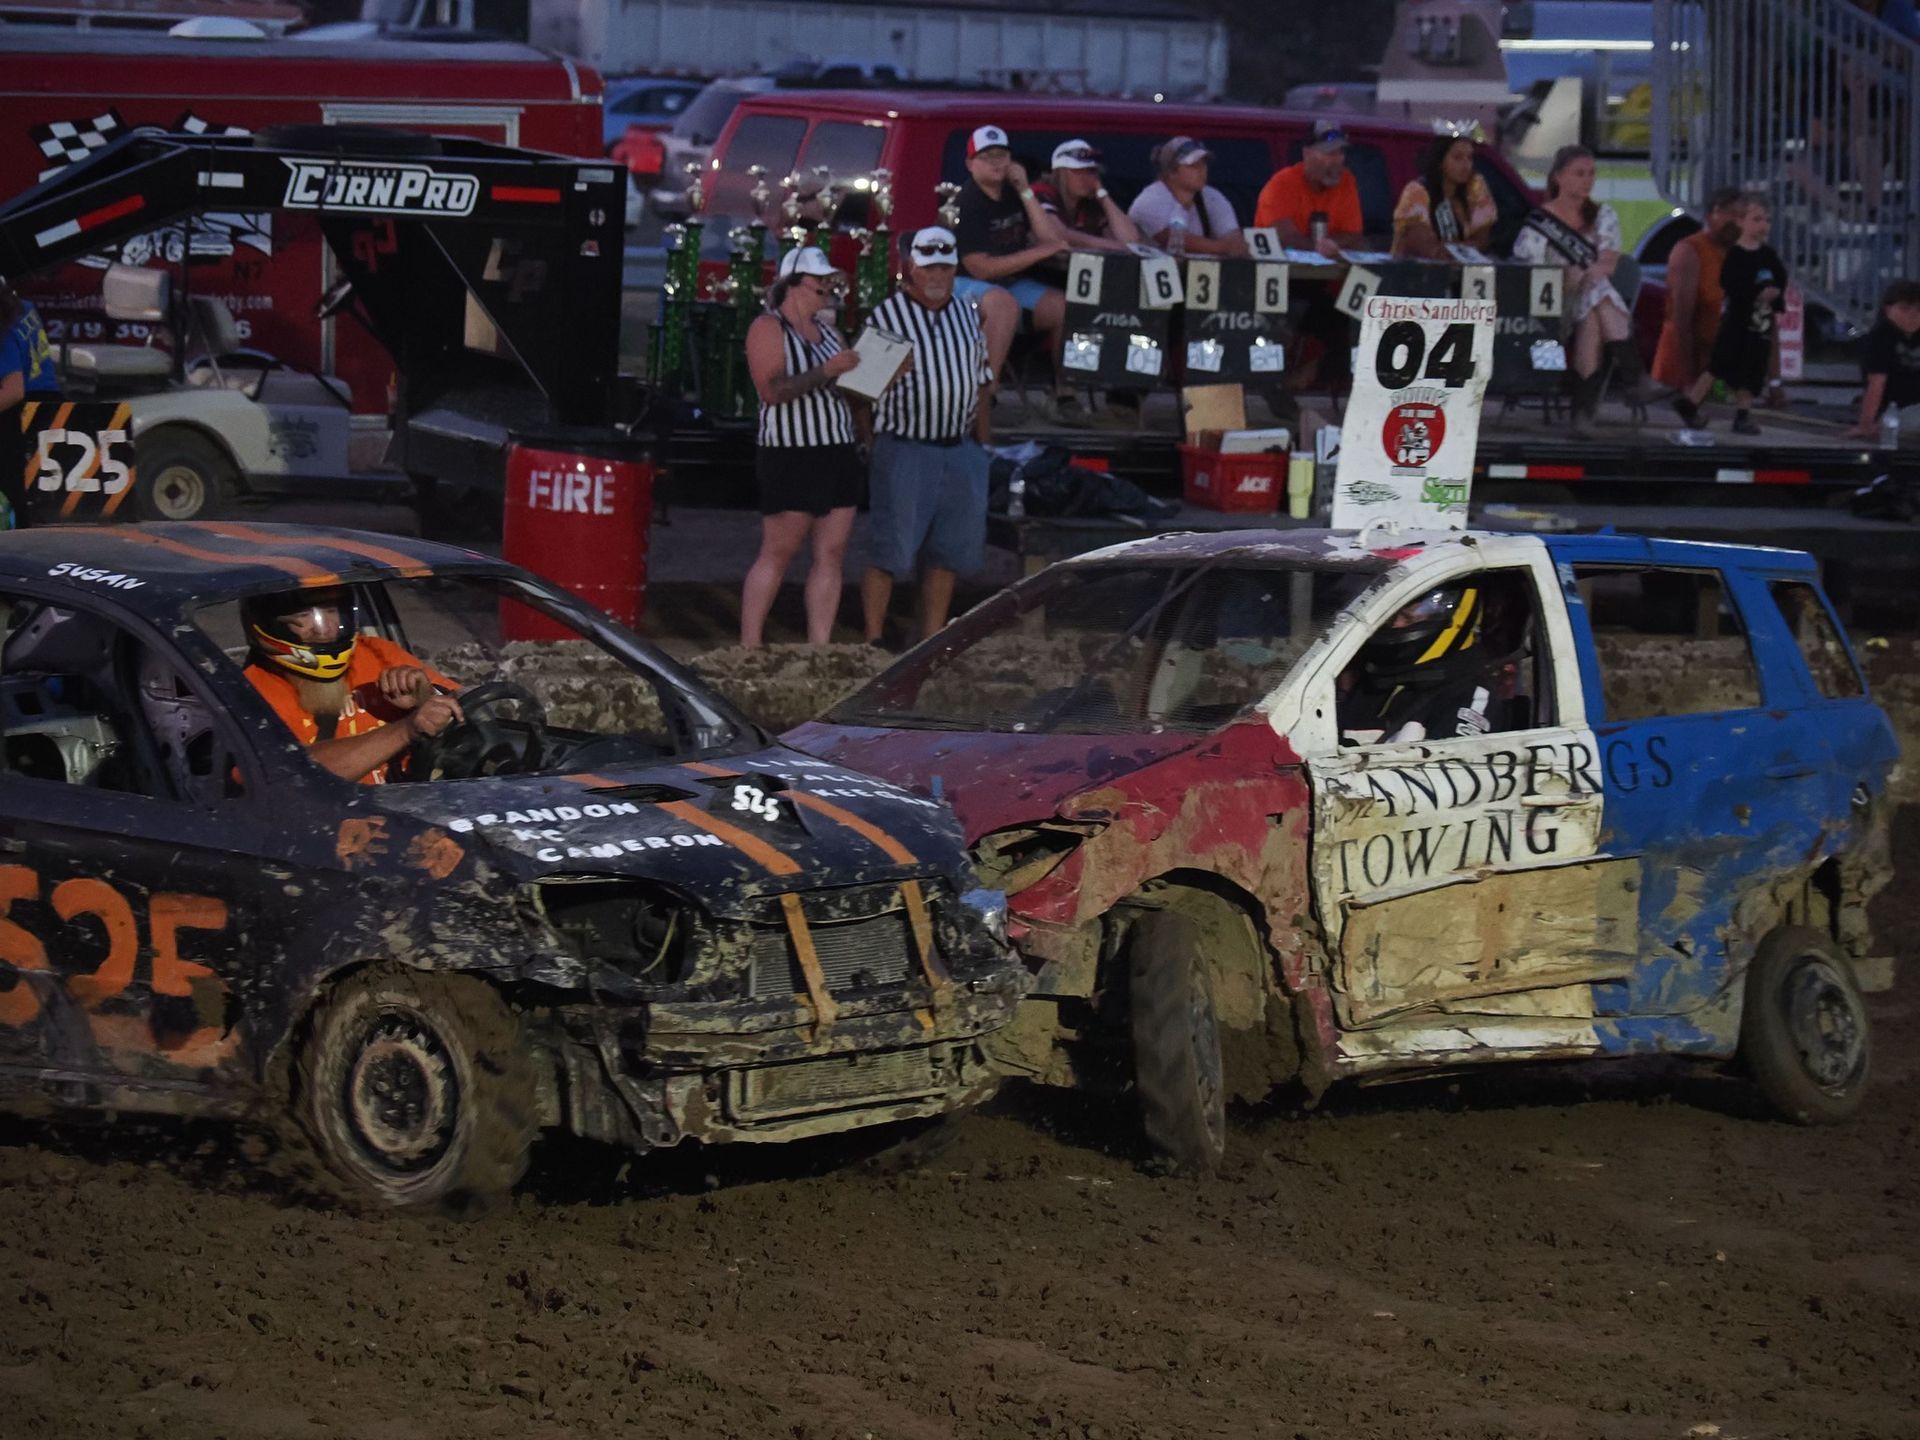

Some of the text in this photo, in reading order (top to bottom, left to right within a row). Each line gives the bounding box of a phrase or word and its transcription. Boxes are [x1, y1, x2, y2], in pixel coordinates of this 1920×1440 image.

[1254, 233, 1271, 254] 9
[1078, 268, 1093, 297] 6
[1156, 271, 1172, 298] 6
[1196, 274, 1210, 303] 3
[1265, 278, 1279, 305] 6
[1348, 283, 1367, 310] 6
[1540, 282, 1554, 311] 4
[1092, 312, 1142, 328] STIGA
[1367, 298, 1496, 326] Chris Sandberg
[1494, 316, 1546, 334] TIGA
[1375, 321, 1476, 389] 04
[38, 428, 130, 494] 525
[528, 469, 616, 514] FIRE
[47, 562, 147, 590] SUSAN
[449, 802, 640, 832] BRANDON
[730, 784, 780, 822] 525
[512, 828, 566, 842] KC
[536, 832, 724, 862] CAMERON
[1336, 805, 1558, 894] TOWING
